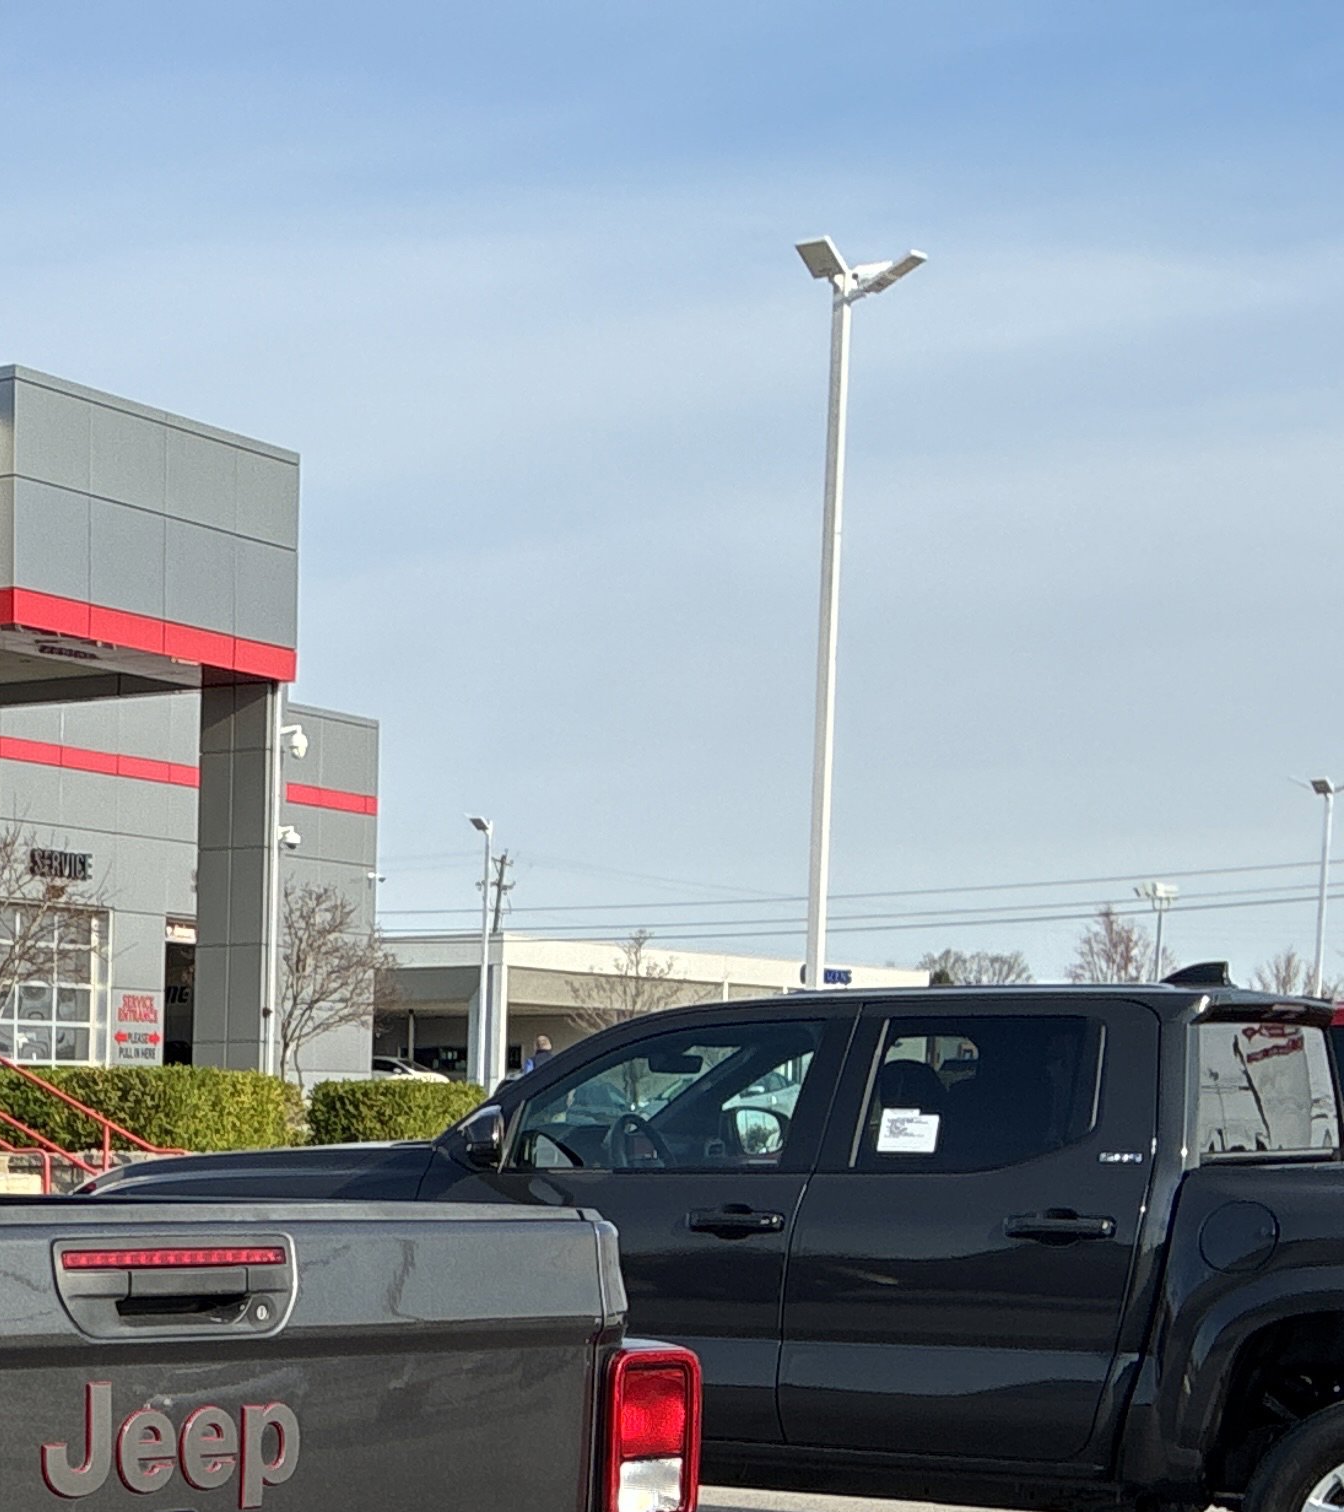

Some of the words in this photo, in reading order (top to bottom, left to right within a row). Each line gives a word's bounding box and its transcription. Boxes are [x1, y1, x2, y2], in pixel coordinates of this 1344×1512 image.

[30, 848, 93, 881] SERVICE
[127, 1032, 150, 1045] PLEASE
[119, 1047, 133, 1059] PULL
[141, 1048, 156, 1060] HERE
[41, 1381, 300, 1509] Jeep
